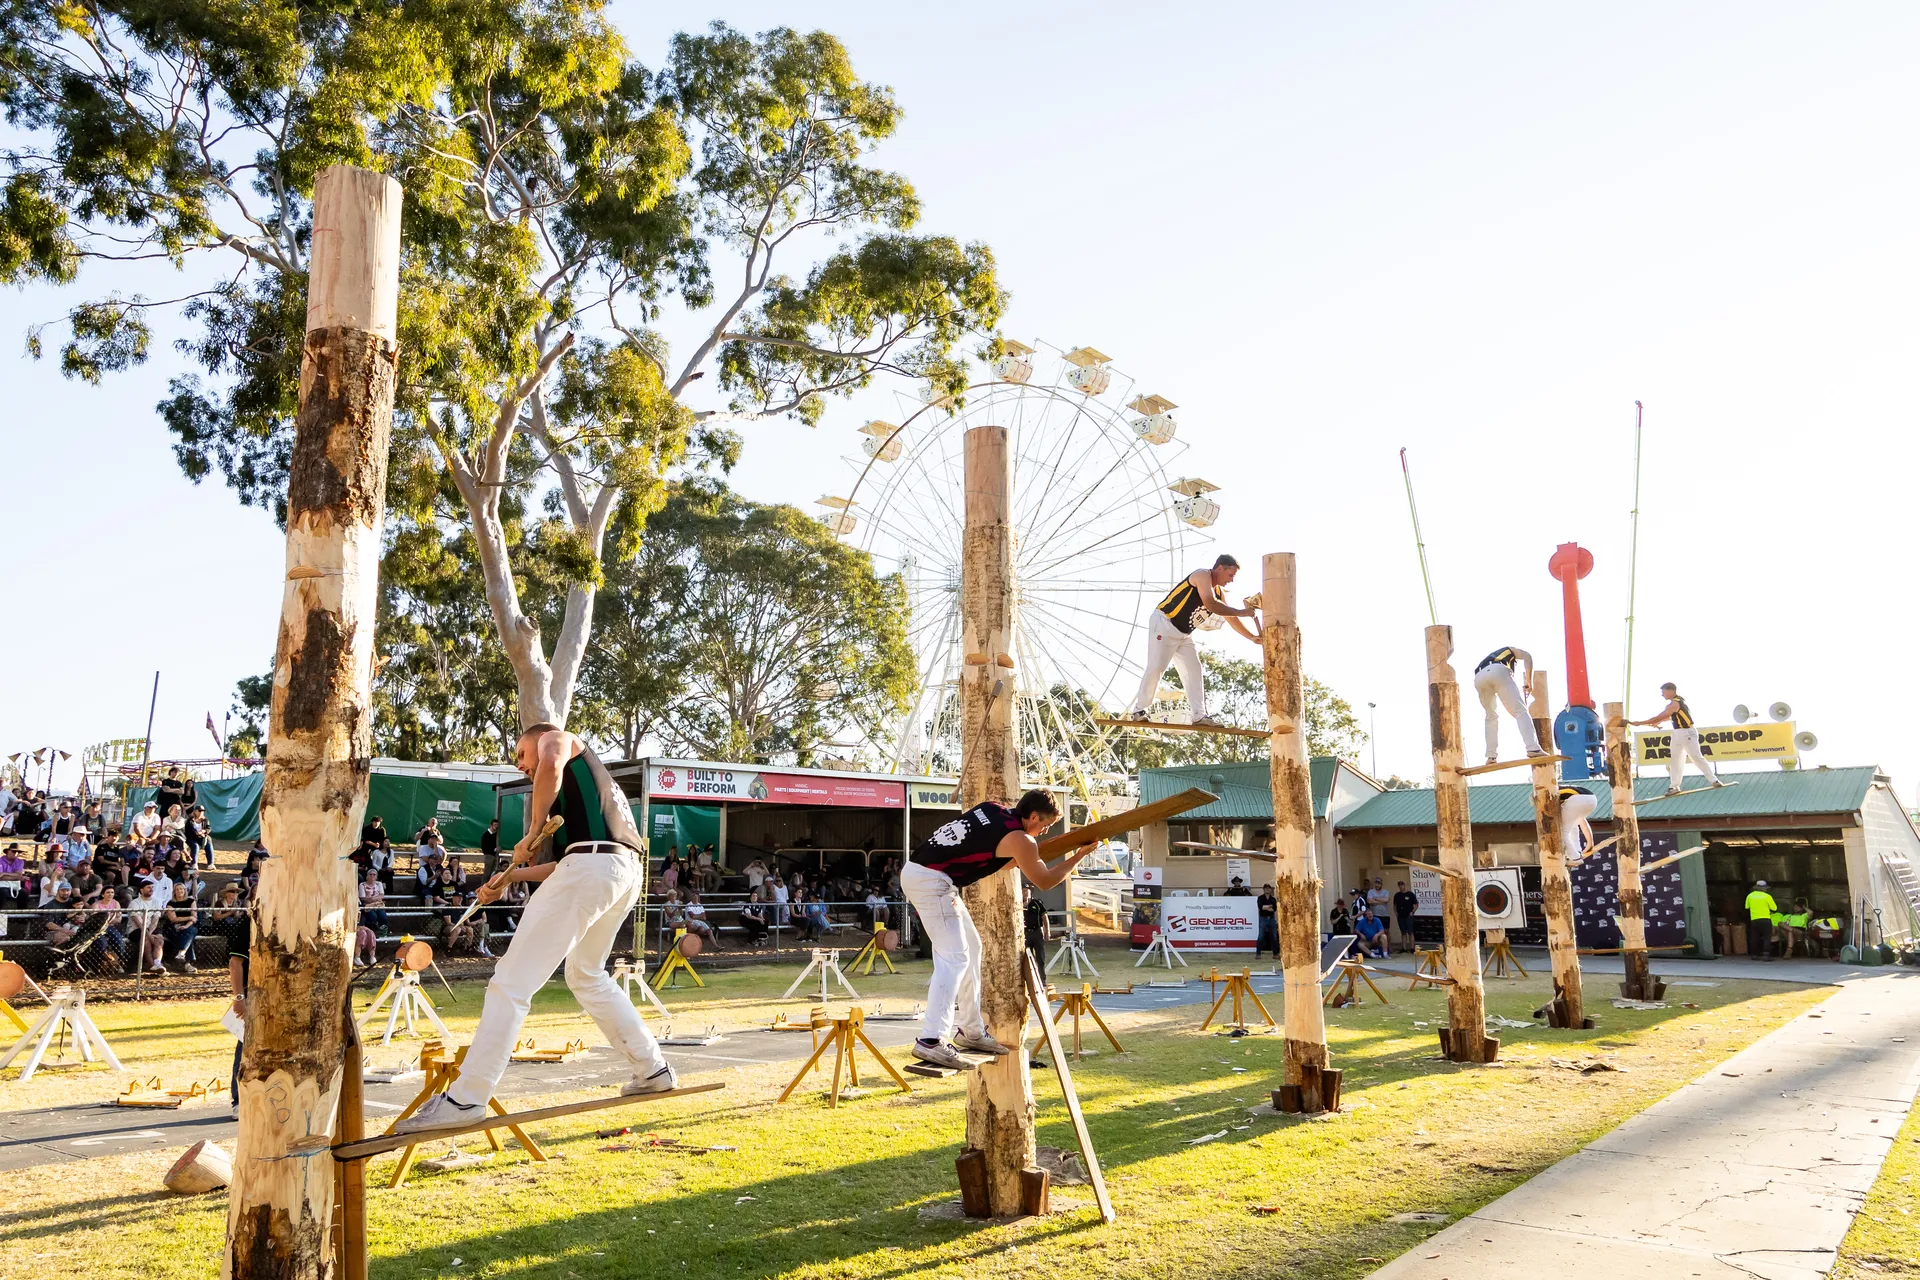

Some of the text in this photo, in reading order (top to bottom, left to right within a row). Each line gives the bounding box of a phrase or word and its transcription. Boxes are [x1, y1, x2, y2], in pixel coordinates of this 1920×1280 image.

[1643, 730, 1763, 747] WOCHOP
[1645, 745, 1713, 760] ARA
[687, 769, 733, 782] BUILT TO
[687, 782, 736, 794] PERFORM
[918, 792, 962, 804] WOO
[1412, 870, 1436, 878] Shaw
[1413, 880, 1430, 888] and
[1414, 889, 1442, 898] Partne
[1189, 918, 1252, 926] GENERAL
